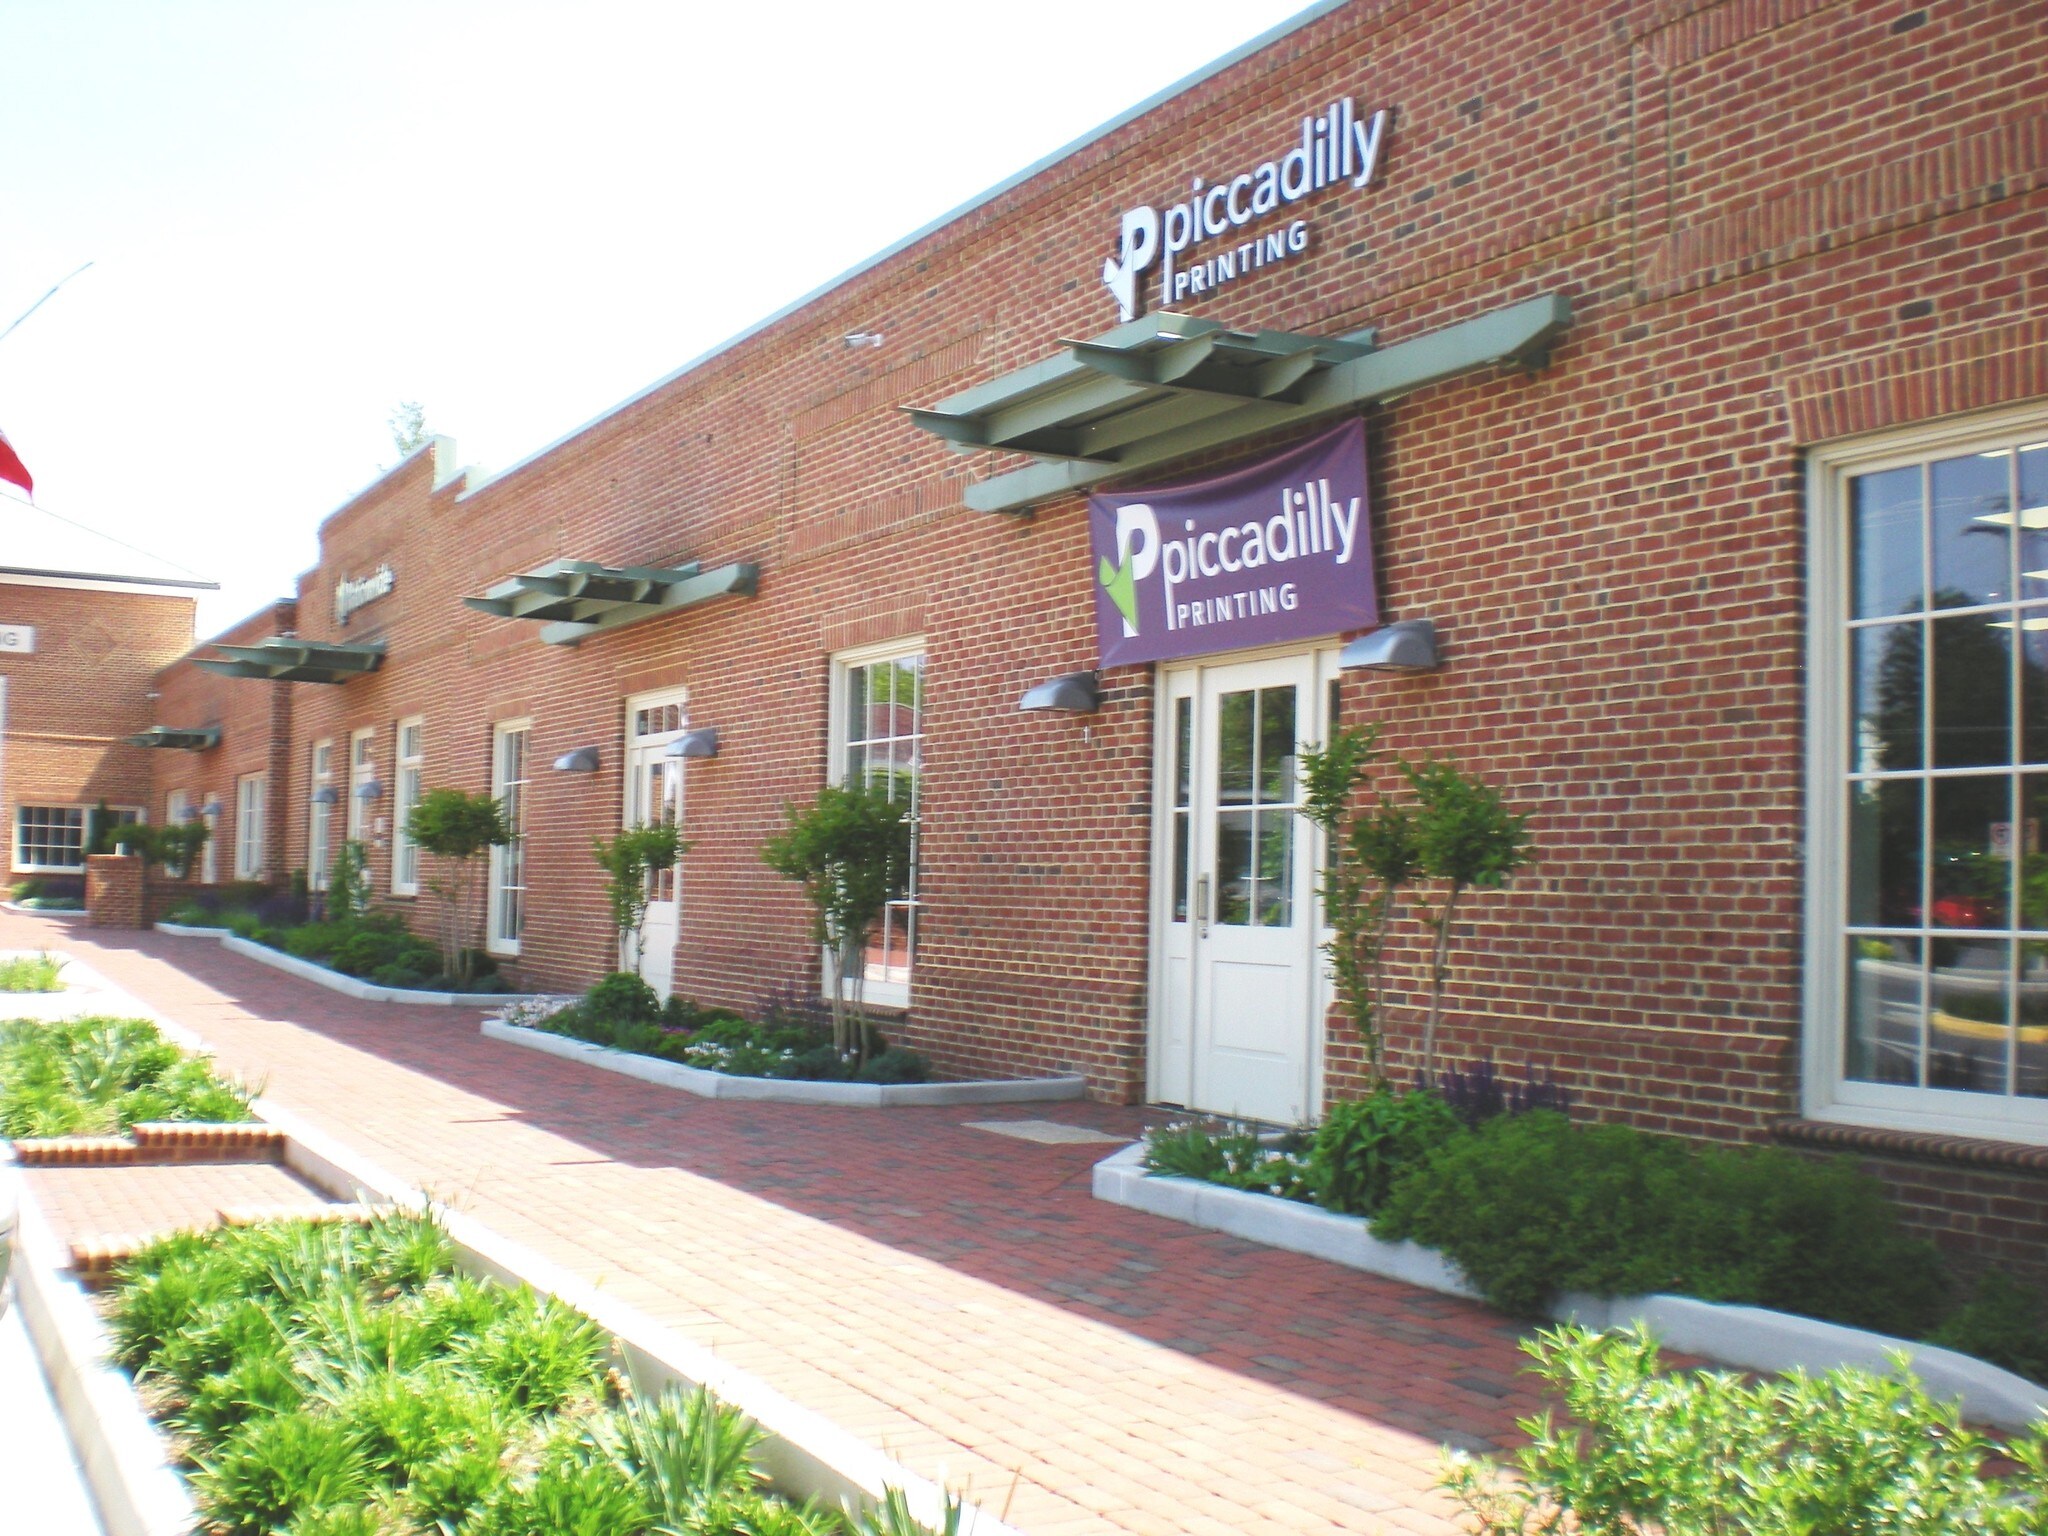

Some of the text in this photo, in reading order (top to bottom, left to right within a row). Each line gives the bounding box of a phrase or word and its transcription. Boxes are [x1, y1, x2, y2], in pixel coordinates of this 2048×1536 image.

[1163, 96, 1386, 304] piccadilly
[1174, 220, 1309, 301] PRINTING
[1162, 478, 1361, 631] piccadilly
[1177, 583, 1299, 629] PRINTING
